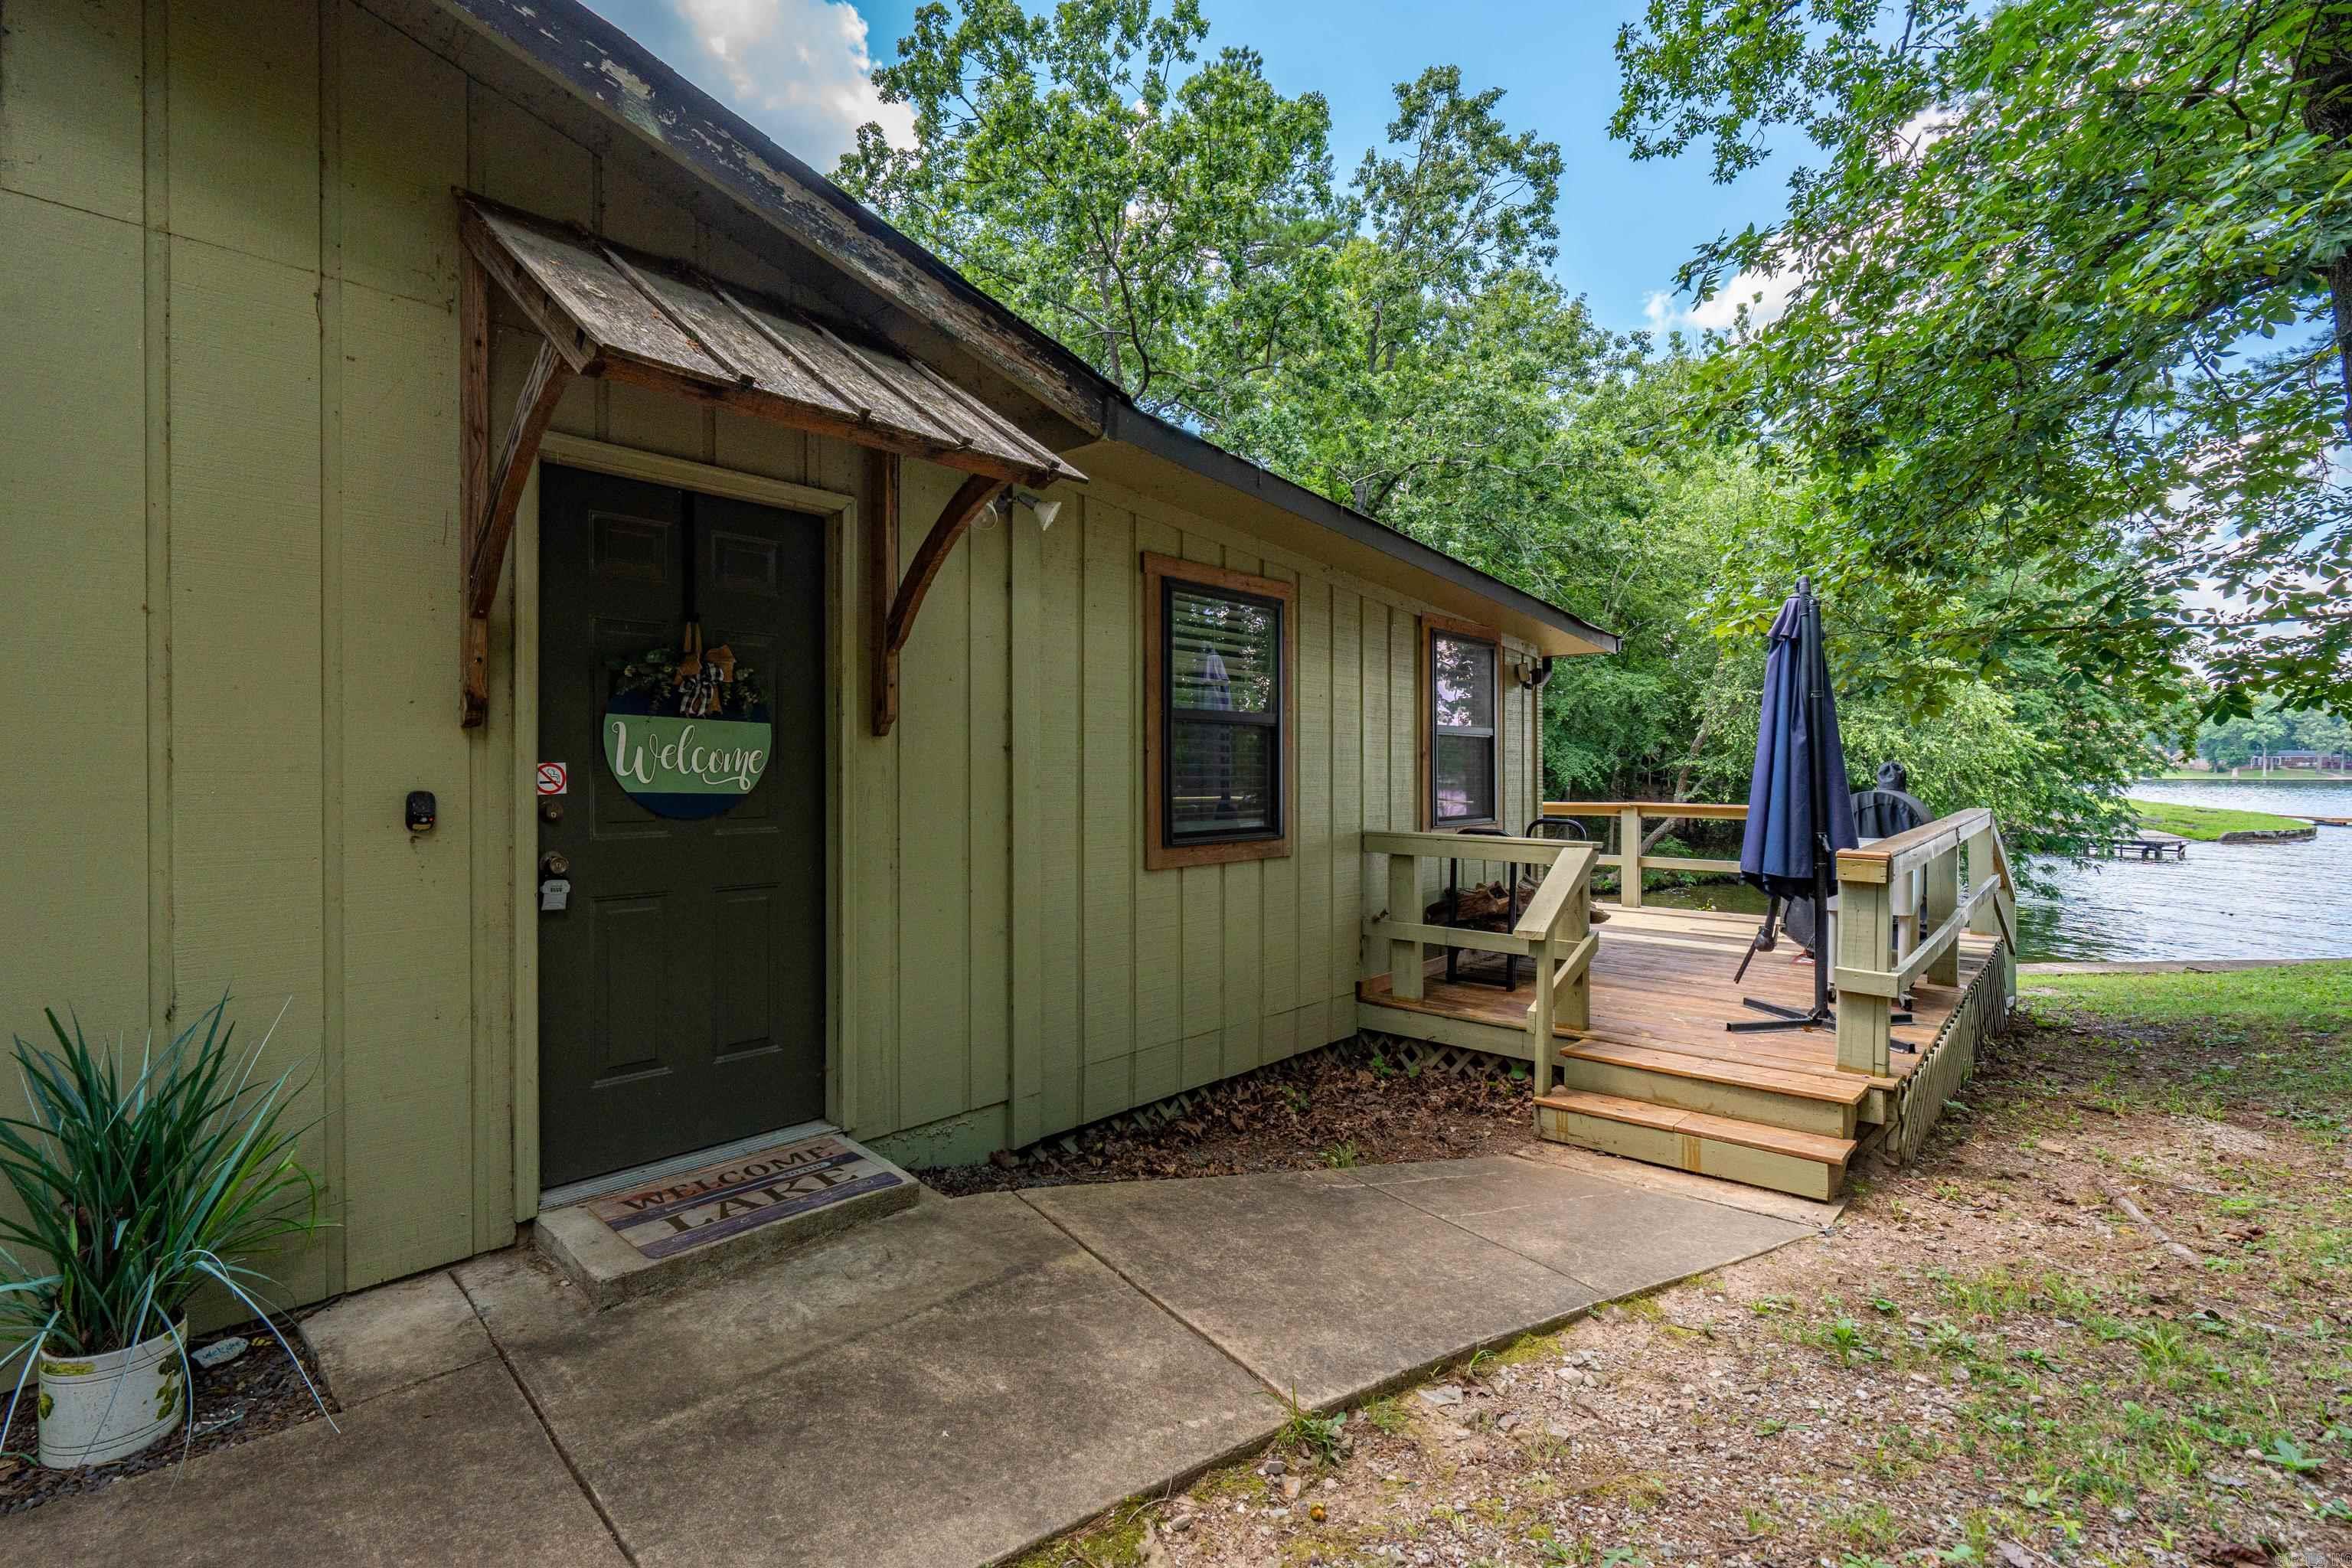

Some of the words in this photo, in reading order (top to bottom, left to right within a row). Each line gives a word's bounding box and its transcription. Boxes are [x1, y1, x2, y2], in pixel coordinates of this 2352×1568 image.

[612, 721, 766, 791] Welcome
[621, 1146, 833, 1210] WELCOME
[663, 1167, 858, 1233] LAKE
